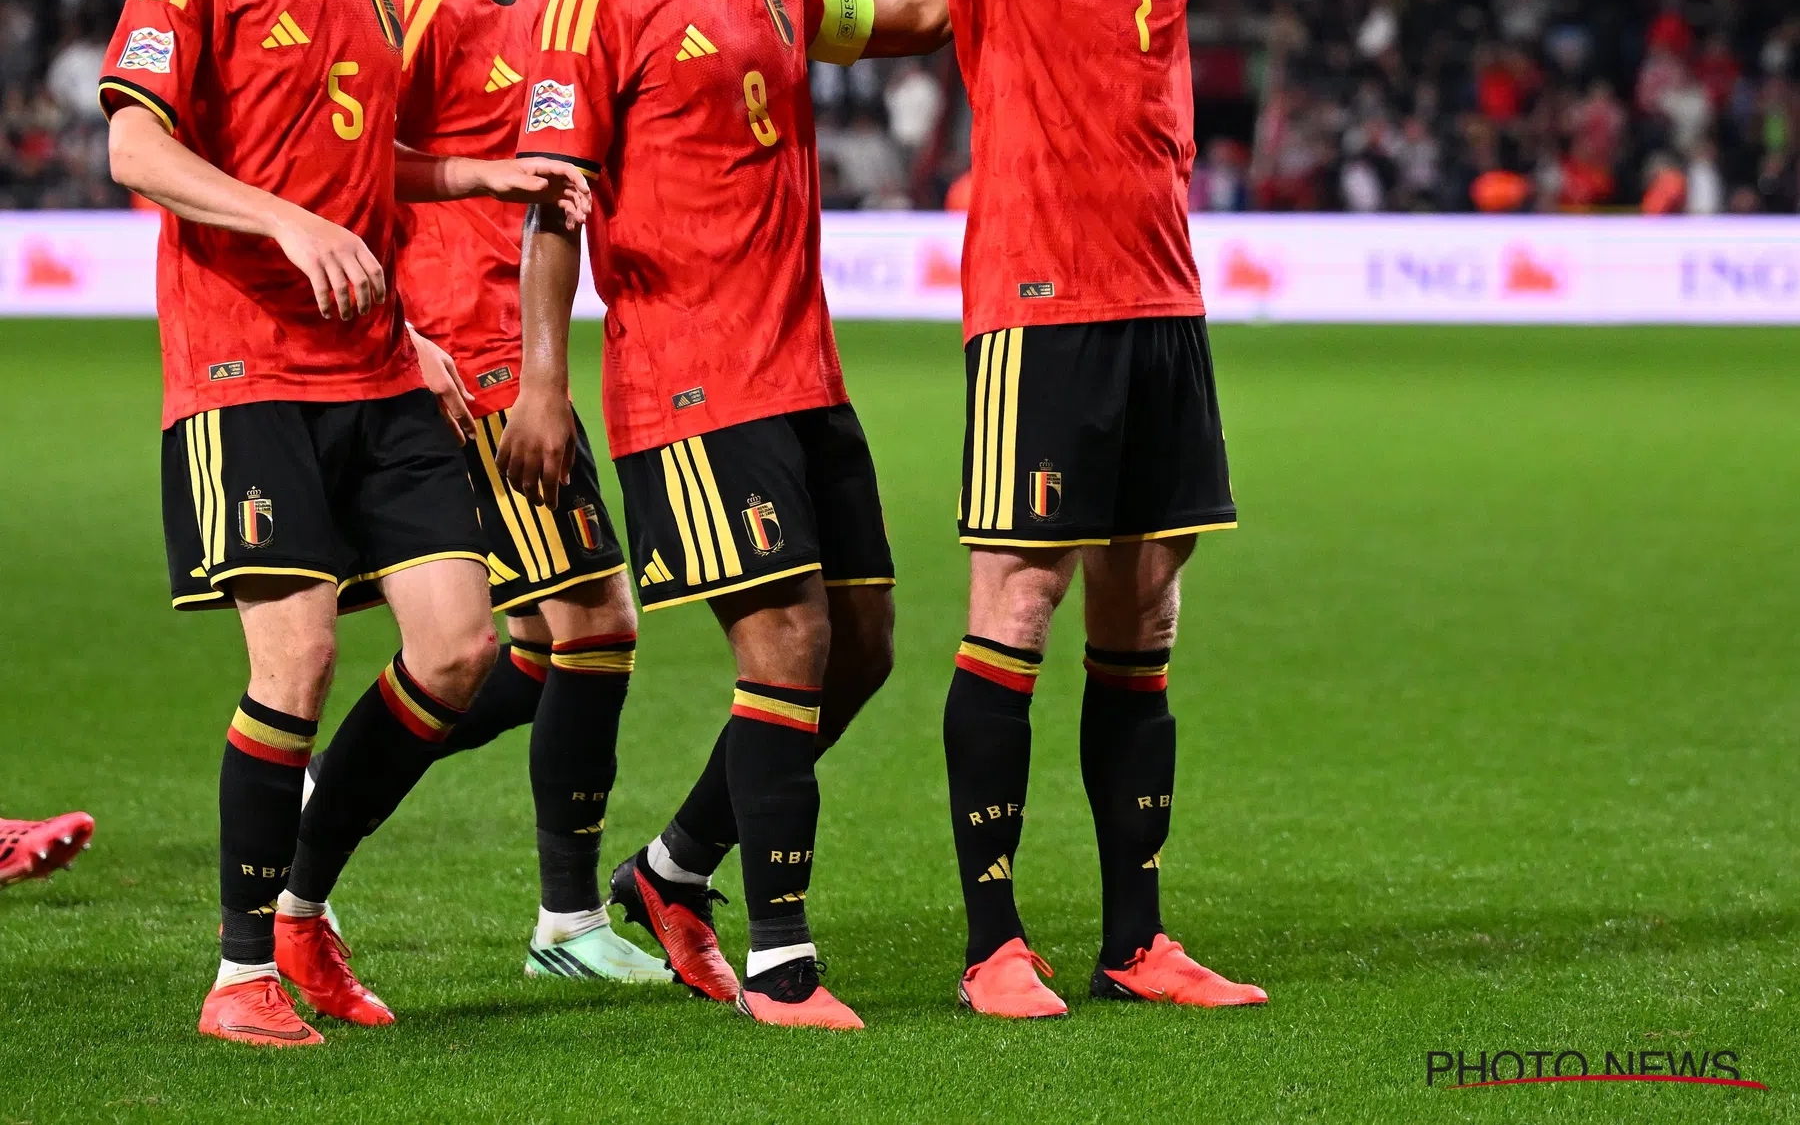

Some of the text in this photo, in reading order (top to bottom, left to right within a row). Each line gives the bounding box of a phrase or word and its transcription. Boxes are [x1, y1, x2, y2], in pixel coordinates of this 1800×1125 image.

[328, 61, 363, 141] 5
[743, 71, 777, 147] 8
[1366, 248, 1488, 299] ING
